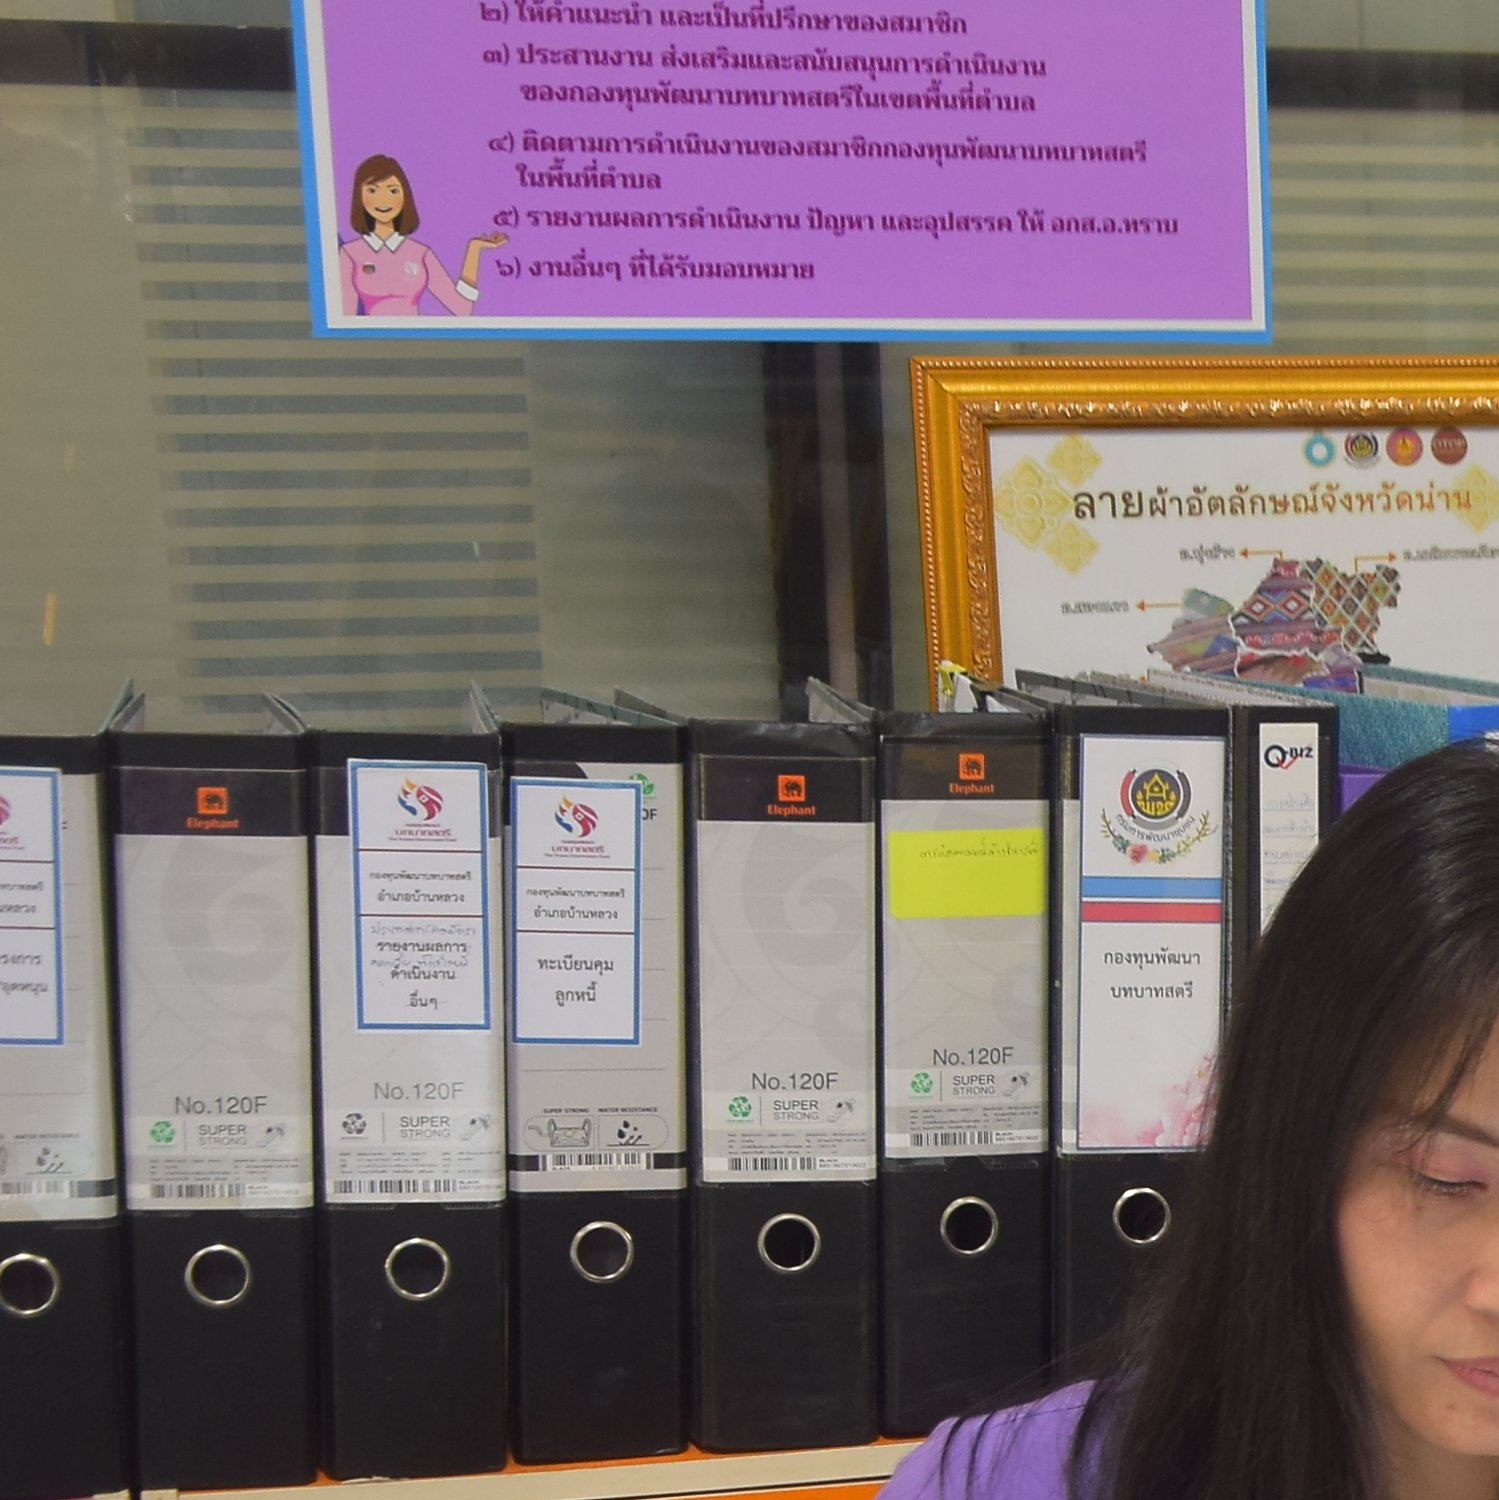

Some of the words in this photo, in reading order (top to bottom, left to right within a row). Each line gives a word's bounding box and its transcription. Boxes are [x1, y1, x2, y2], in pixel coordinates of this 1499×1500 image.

[516, 43, 653, 67] ประสานงาน
[660, 44, 1047, 81] ส่งเสริมและสนับสนุนการดำเนินงาน
[515, 157, 662, 190] ในพื้นที่ตำบล
[526, 205, 801, 231] รายงานผลการดำเนินงาน
[806, 206, 875, 237] ปัญหา
[881, 210, 1012, 240] และอุปสรรค
[628, 248, 815, 280] ที่ได้รับมอบหมาย
[1072, 481, 1474, 521] ลายผ้าอัตลักษณ์จังหวัดน่าน
[949, 782, 995, 796] Elephant
[767, 803, 816, 817] Elephant
[186, 816, 241, 831] Elephant
[377, 888, 465, 903] อำเภอบ้านหลวง
[533, 904, 619, 921] อำเภอบ้านหลวง
[376, 941, 468, 953] รายงานผลการ
[537, 954, 614, 977] ทะเบียนคุม
[1103, 946, 1201, 971] กองทุนพัฒนา
[390, 964, 456, 980] ดำเนินงาน
[554, 981, 598, 1008] ลูกหนี้
[1110, 980, 1194, 999] บทบาทสตรี
[933, 1046, 1014, 1066] No.120F
[751, 1071, 839, 1091] No.120F
[953, 1074, 996, 1086] SUPER
[373, 1081, 465, 1101] No.120F
[953, 1086, 996, 1096] STRONG
[174, 1095, 268, 1115] No.120F
[773, 1099, 819, 1111] SUPER
[400, 1115, 450, 1128] SUPER
[773, 1111, 819, 1121] STRONG
[198, 1123, 247, 1136] SUPER
[400, 1128, 451, 1139] STRONG
[198, 1136, 248, 1147] STRONG
